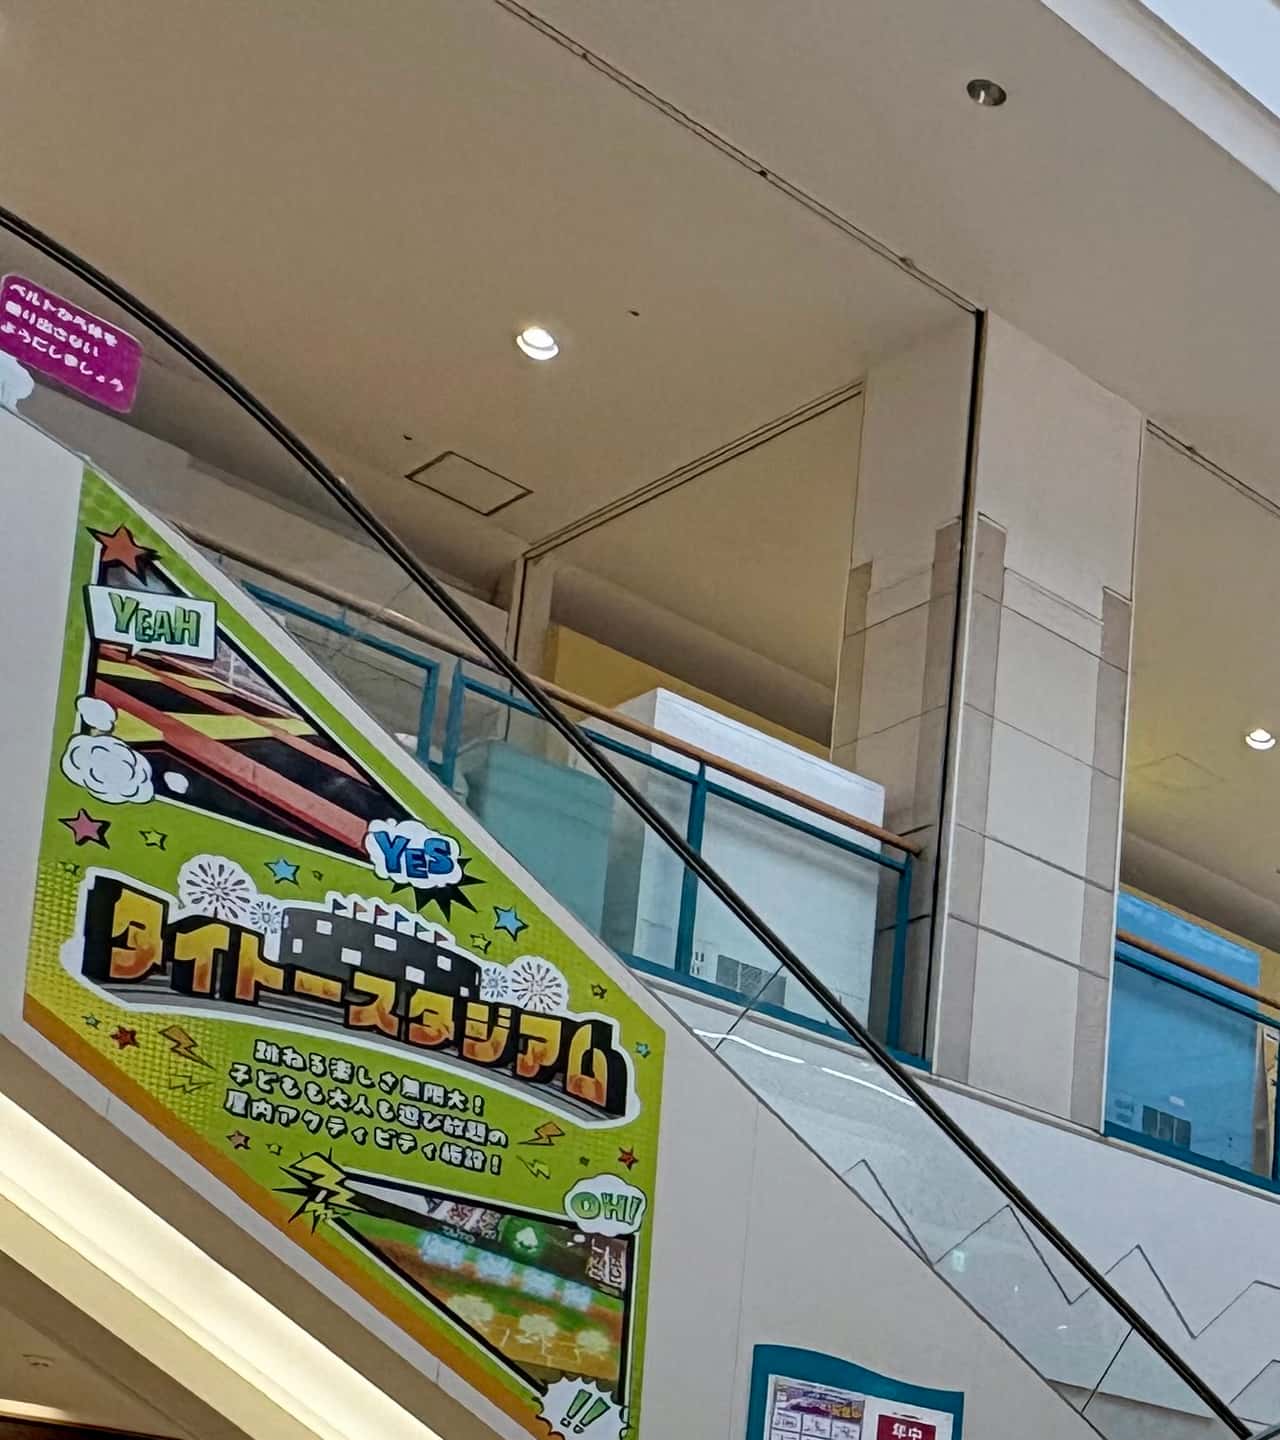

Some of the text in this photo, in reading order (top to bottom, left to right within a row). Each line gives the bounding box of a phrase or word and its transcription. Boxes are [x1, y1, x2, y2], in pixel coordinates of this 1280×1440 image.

[108, 593, 201, 646] YEAH
[373, 831, 453, 879] YES
[106, 887, 609, 1108] タイトースタジアム
[571, 1190, 642, 1226] OH!
